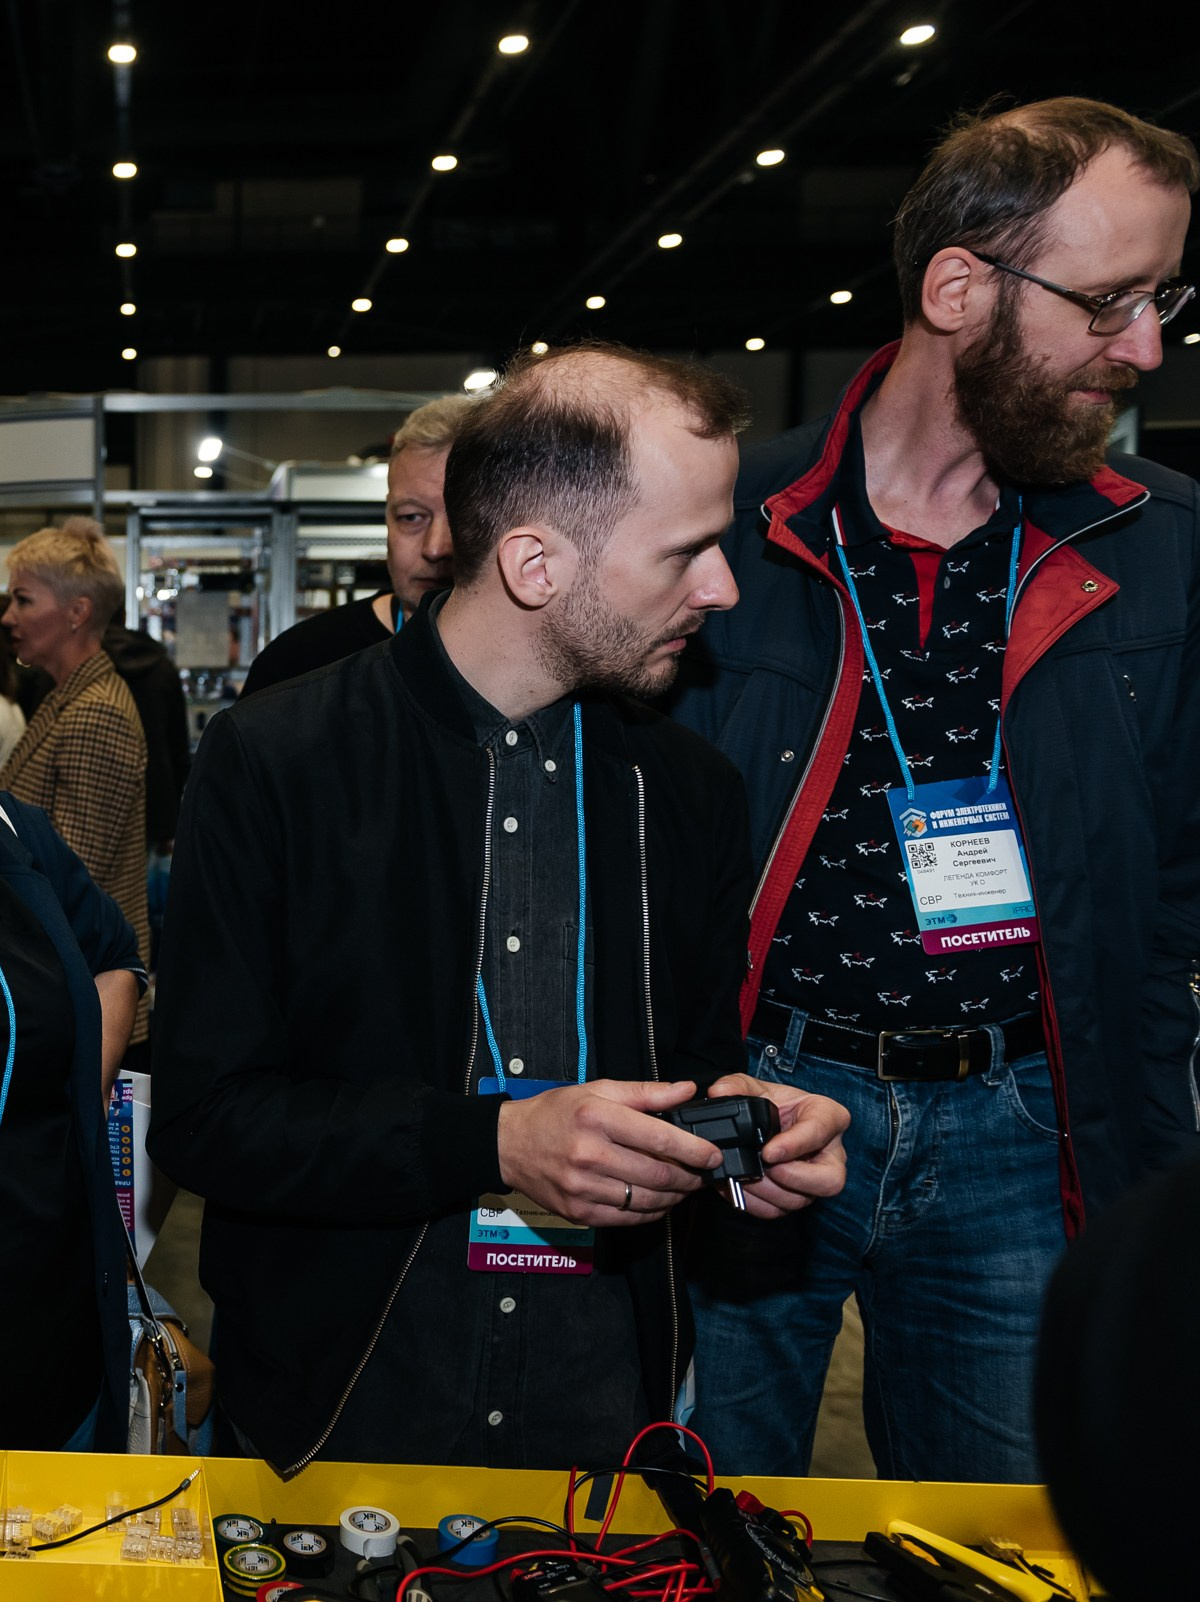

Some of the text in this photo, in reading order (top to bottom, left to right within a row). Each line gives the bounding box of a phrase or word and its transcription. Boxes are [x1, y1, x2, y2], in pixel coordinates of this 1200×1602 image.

[929, 802, 1007, 820] ФОРУМ ЭЛЕКТРОТЕХНИКИ
[931, 811, 1010, 829] И ИНЖЕНЕРНЫХ СИСТЕМ
[950, 837, 990, 848] КОРНЕЕВ
[957, 847, 988, 857] Андрей
[952, 857, 996, 868] Сергеевич
[925, 916, 946, 926] ЭТМ
[940, 927, 1030, 948] ПОСЕТИТЕЛЬ
[477, 1229, 498, 1239] ЭТМ
[486, 1252, 577, 1268] ПОСЕТИТЕЛЬ
